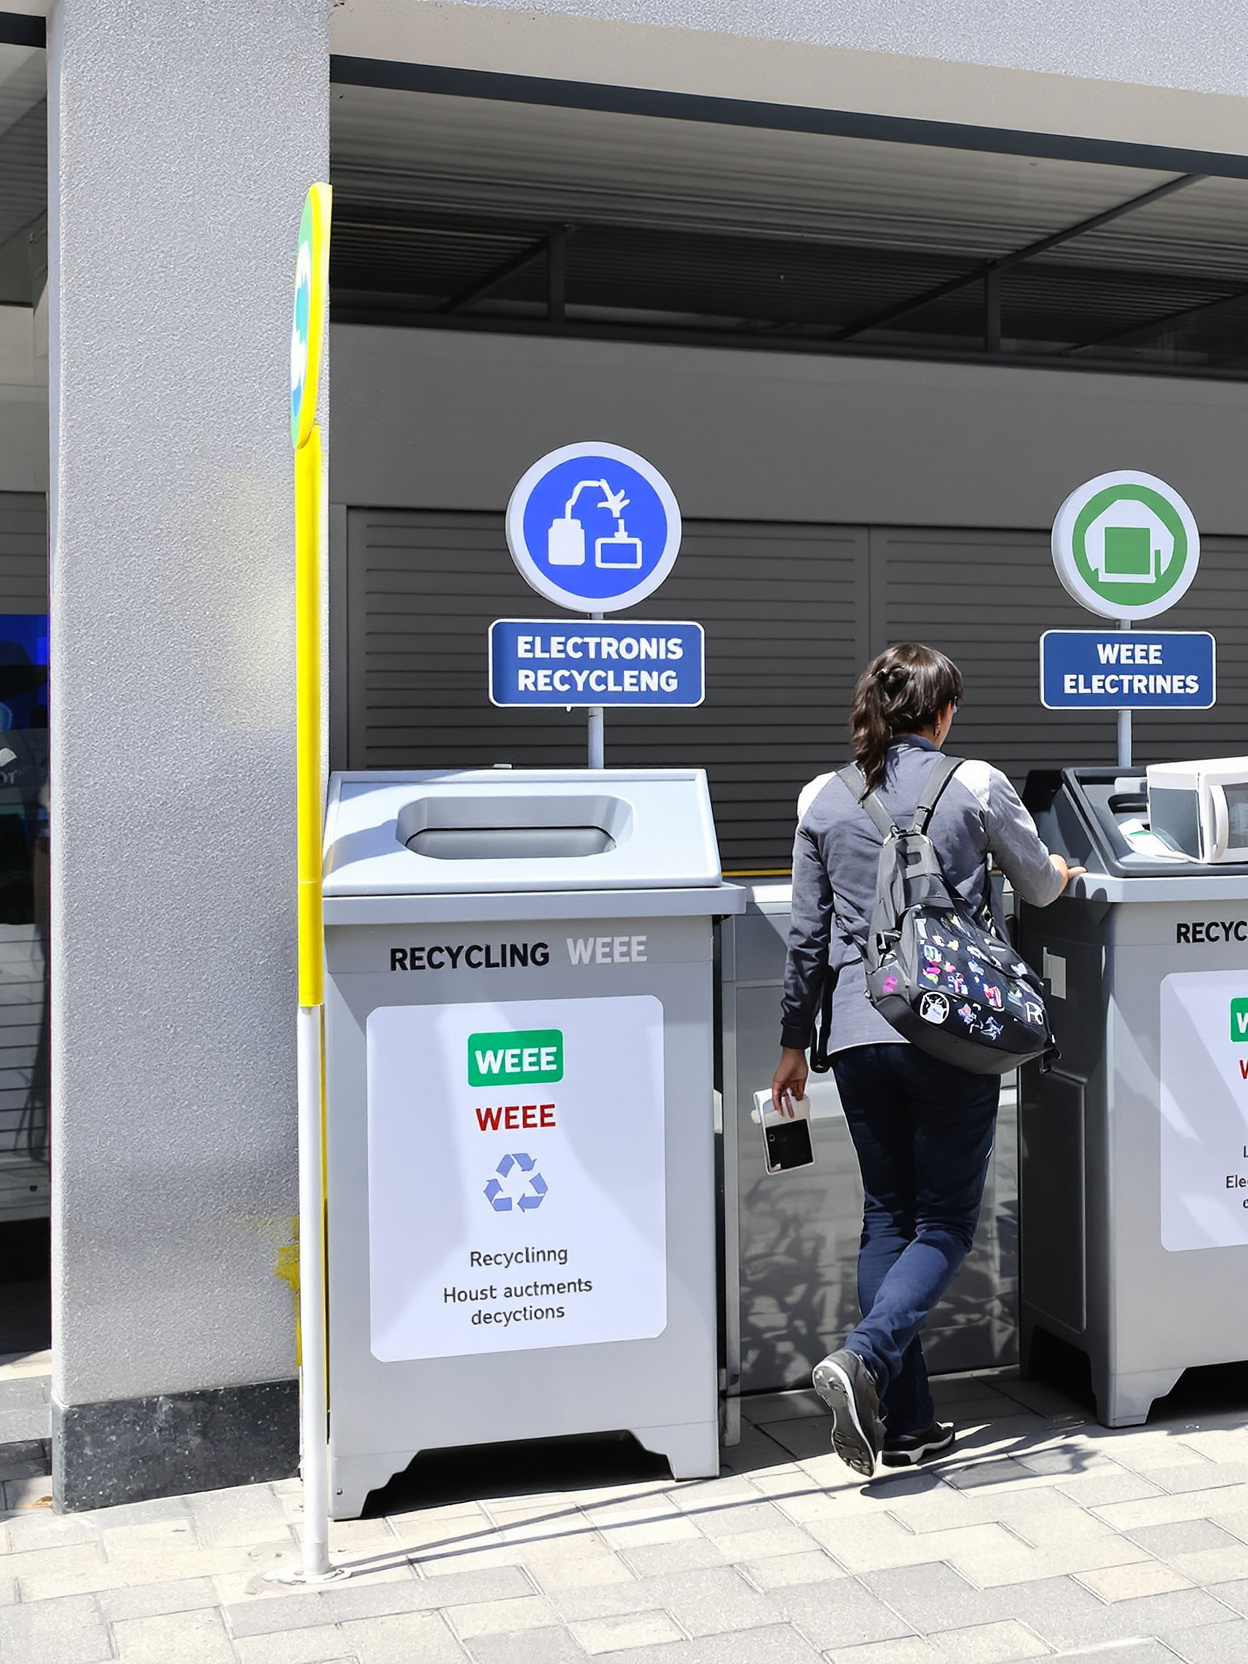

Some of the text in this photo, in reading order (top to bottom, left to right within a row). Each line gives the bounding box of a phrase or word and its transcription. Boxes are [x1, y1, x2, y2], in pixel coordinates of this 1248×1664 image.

[517, 635, 684, 660] ELECTRONIS
[1096, 643, 1163, 665] WEEE
[517, 669, 678, 692] RECYCLENG
[1063, 674, 1200, 695] ELECTRINES
[390, 935, 648, 972] RECYCLING WEEE
[474, 1045, 558, 1075] WEEE
[475, 1103, 557, 1132] WEEE
[470, 1247, 568, 1269] Recyclinng
[443, 1278, 593, 1303] Houst auctments
[471, 1305, 565, 1327] decyctions
